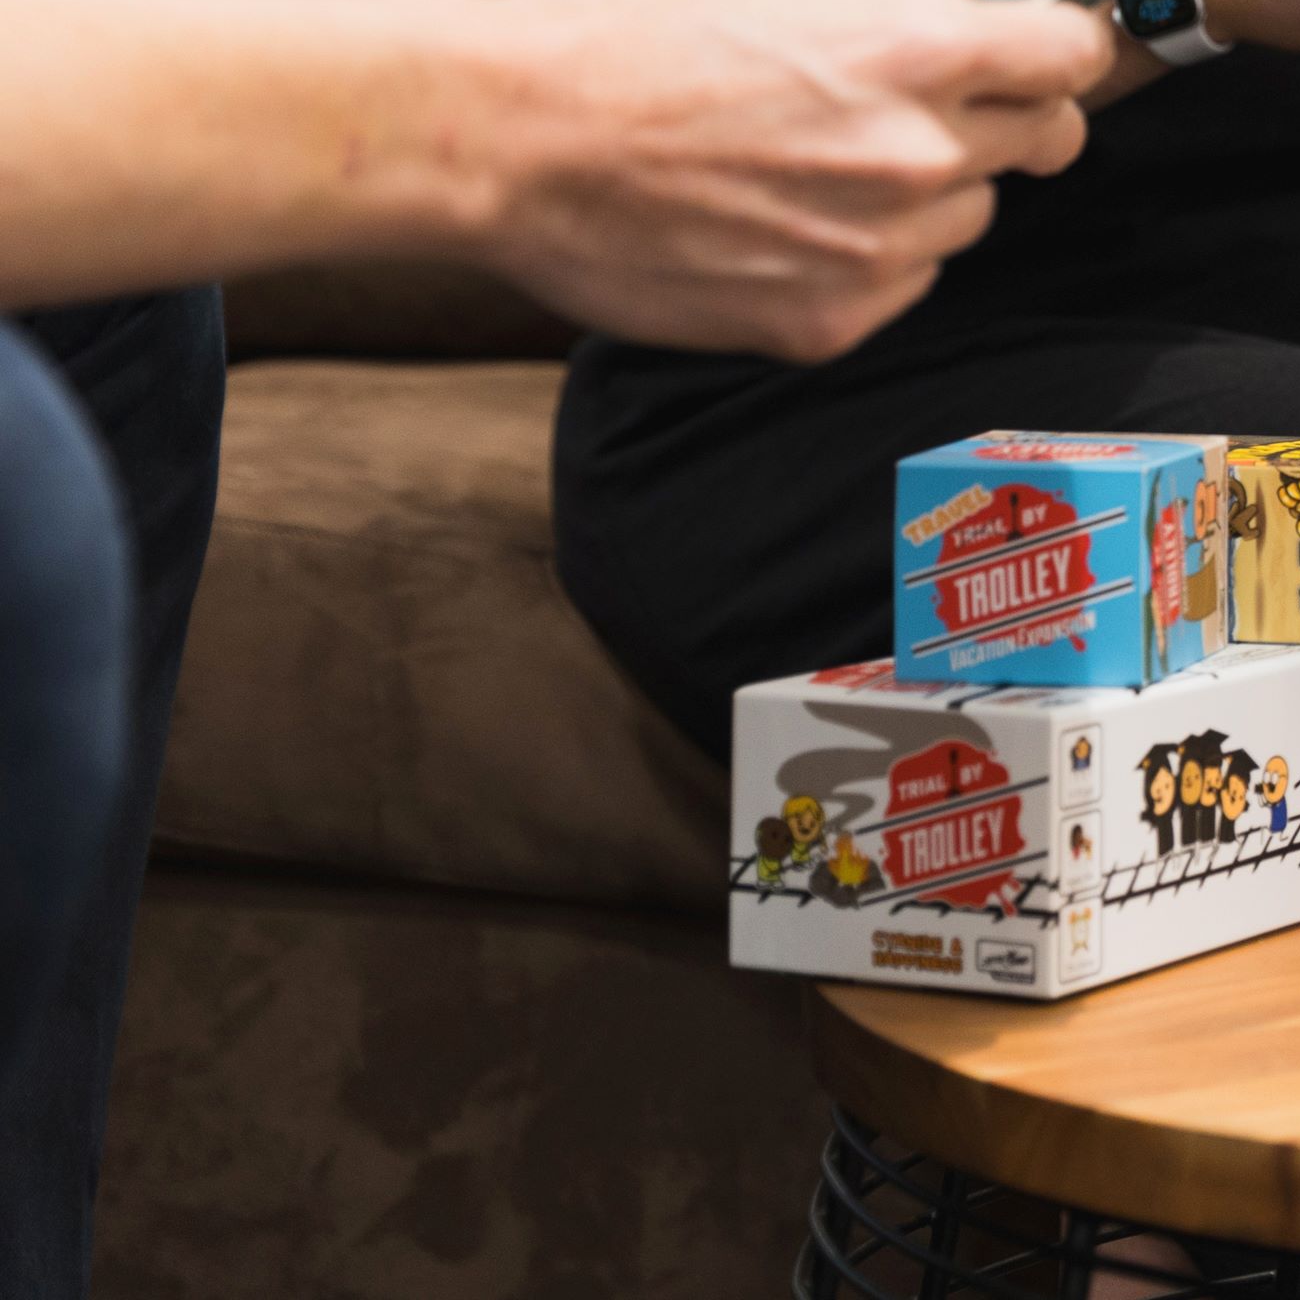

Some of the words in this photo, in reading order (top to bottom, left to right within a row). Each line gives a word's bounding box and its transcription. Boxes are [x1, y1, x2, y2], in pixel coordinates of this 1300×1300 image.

[903, 485, 992, 545] TRAVEL
[953, 518, 1008, 547] TRIAL
[1021, 503, 1048, 527] BY
[954, 546, 1071, 622] TROLLEY
[898, 775, 946, 799] TRIAL
[961, 764, 982, 784] BY
[900, 807, 1006, 878] TROLLEY
